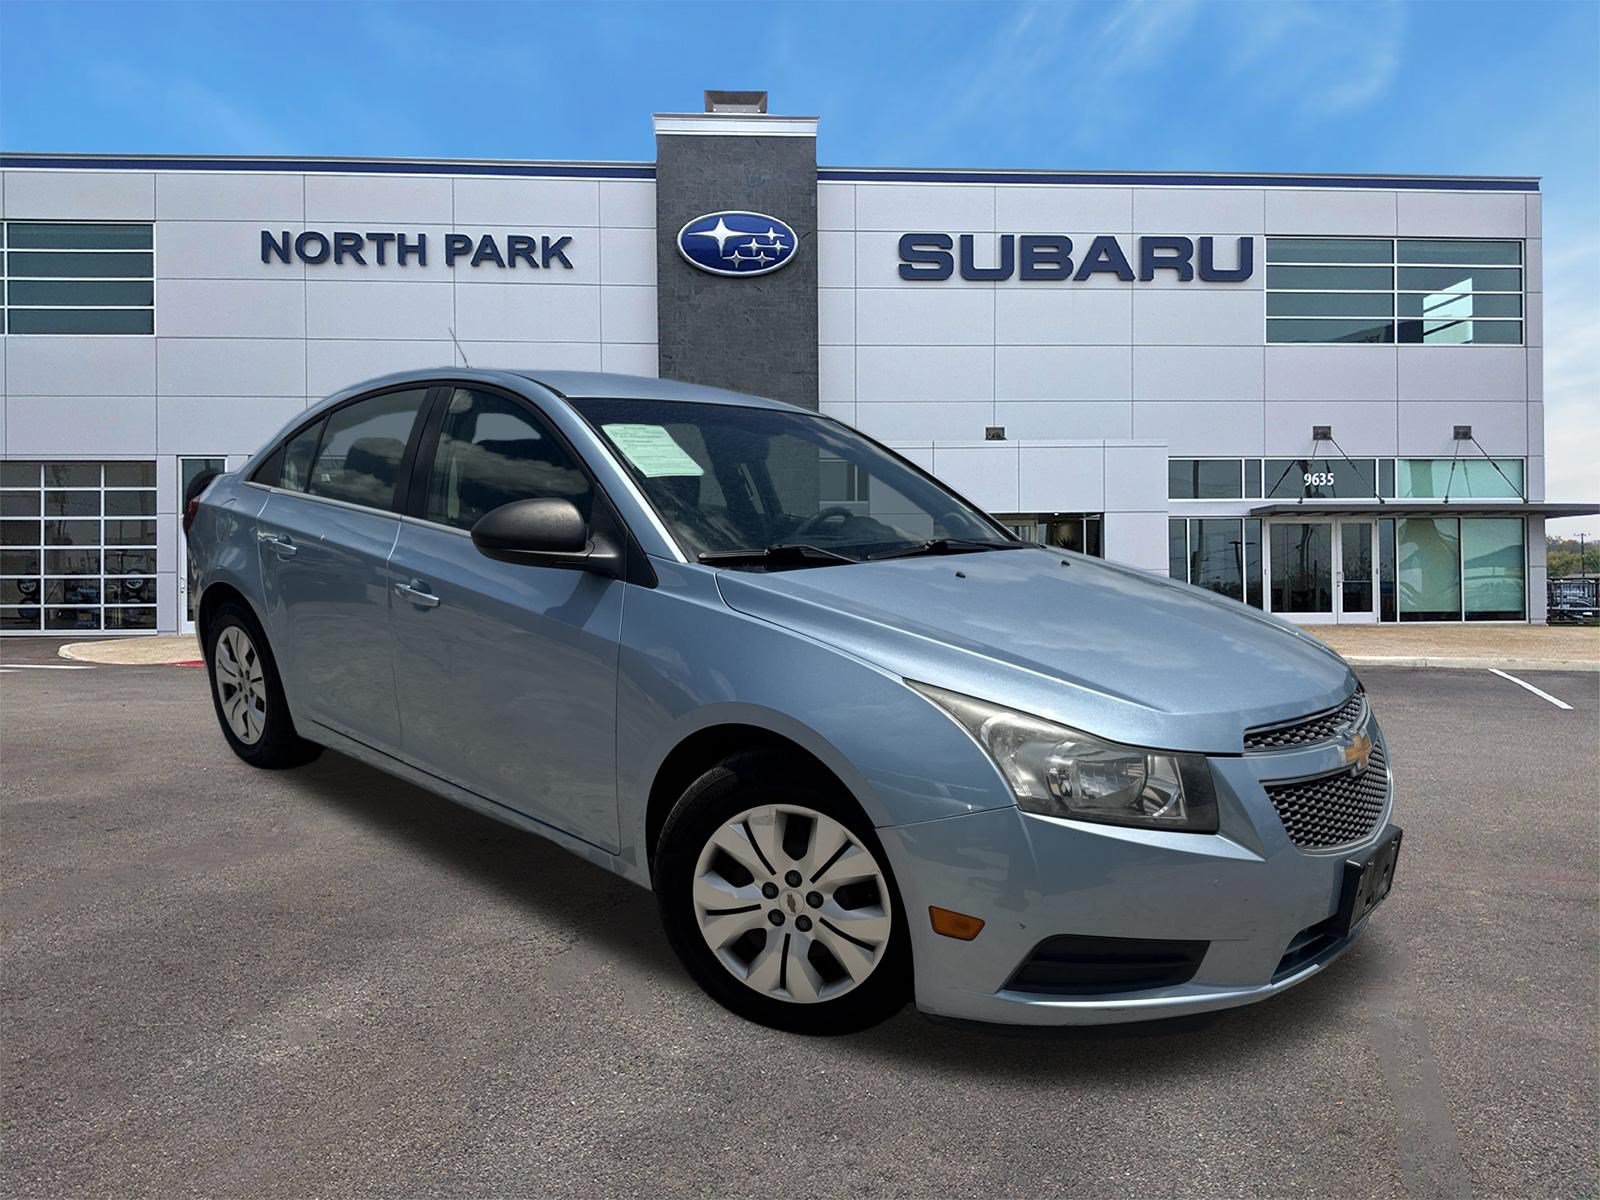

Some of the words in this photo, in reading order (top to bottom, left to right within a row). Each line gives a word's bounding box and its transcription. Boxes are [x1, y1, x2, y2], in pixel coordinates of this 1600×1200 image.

[261, 230, 427, 266] NORTH
[445, 233, 574, 269] PARK
[898, 233, 1254, 282] SUBARU
[1303, 472, 1335, 486] 9635
